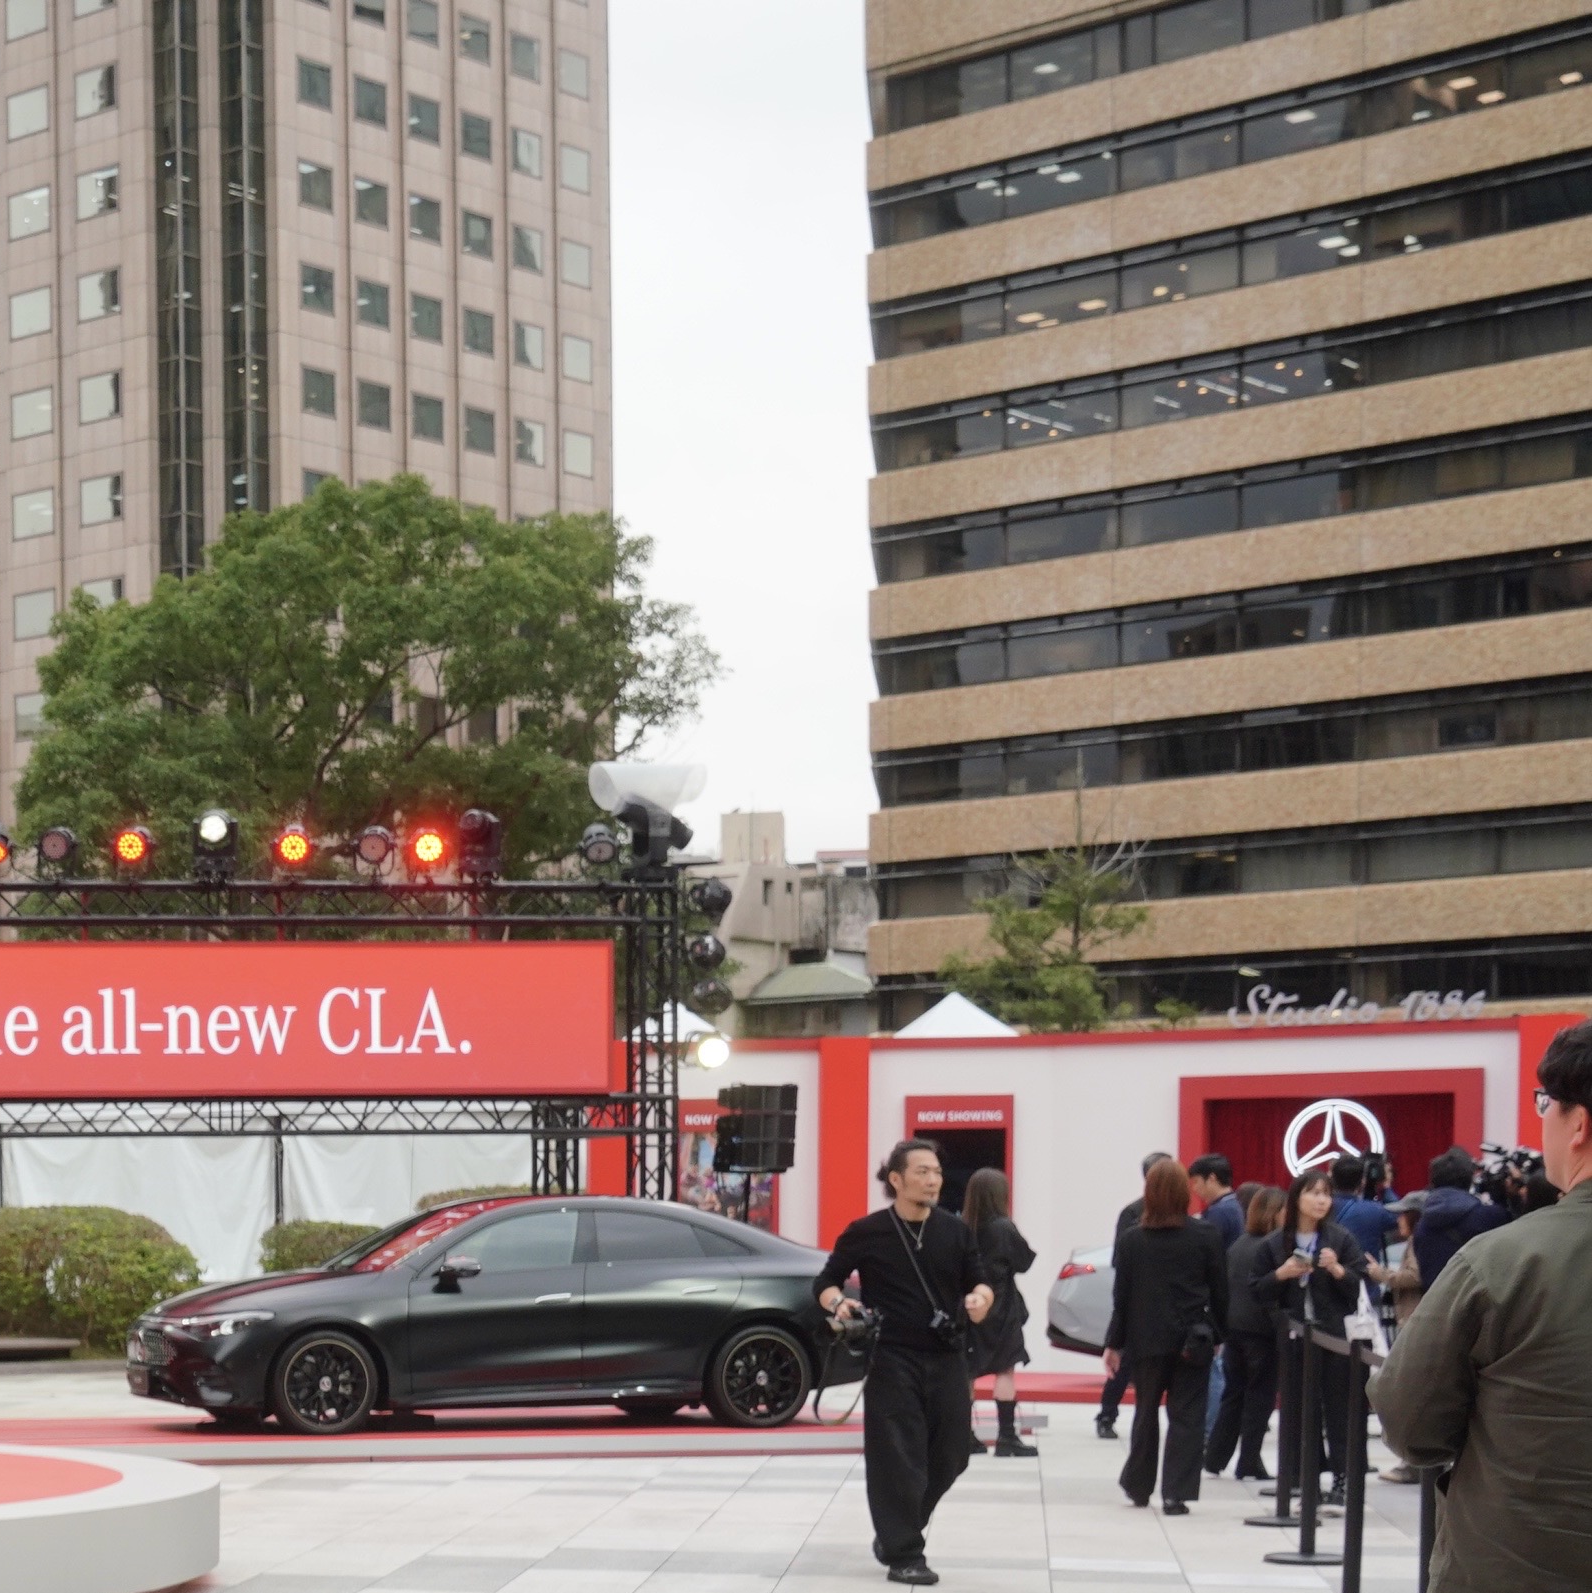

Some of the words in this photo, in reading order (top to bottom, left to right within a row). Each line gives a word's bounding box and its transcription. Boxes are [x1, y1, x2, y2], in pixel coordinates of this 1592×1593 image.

[1227, 983, 1380, 1028] Studio
[1399, 989, 1487, 1022] 1886
[60, 986, 297, 1056] all-new
[318, 986, 473, 1056] CLA.
[684, 1114, 712, 1127] NOW
[917, 1110, 946, 1123] NOW
[947, 1109, 1003, 1122] SHOWING
